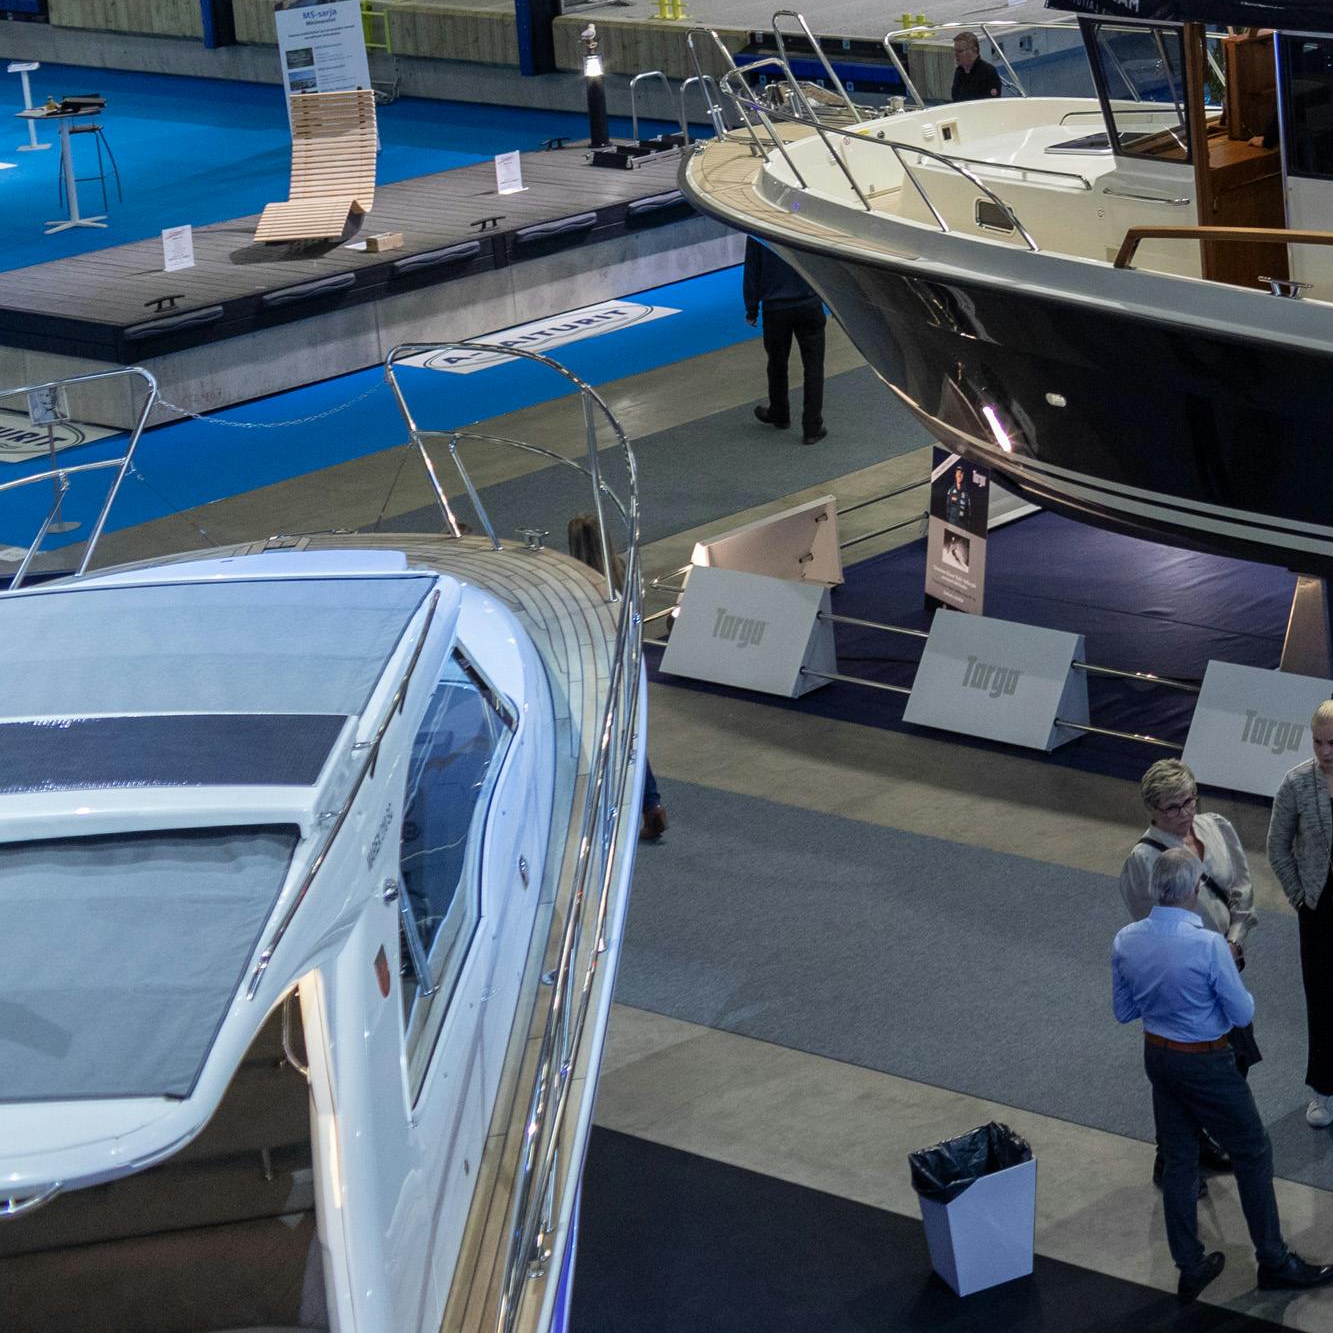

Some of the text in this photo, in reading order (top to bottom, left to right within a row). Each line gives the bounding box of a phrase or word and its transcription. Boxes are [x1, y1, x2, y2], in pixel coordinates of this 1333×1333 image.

[444, 307, 630, 365] A-AITURIT
[711, 607, 767, 648] Targa
[962, 655, 1021, 699] Targa
[1240, 710, 1304, 755] Targa
